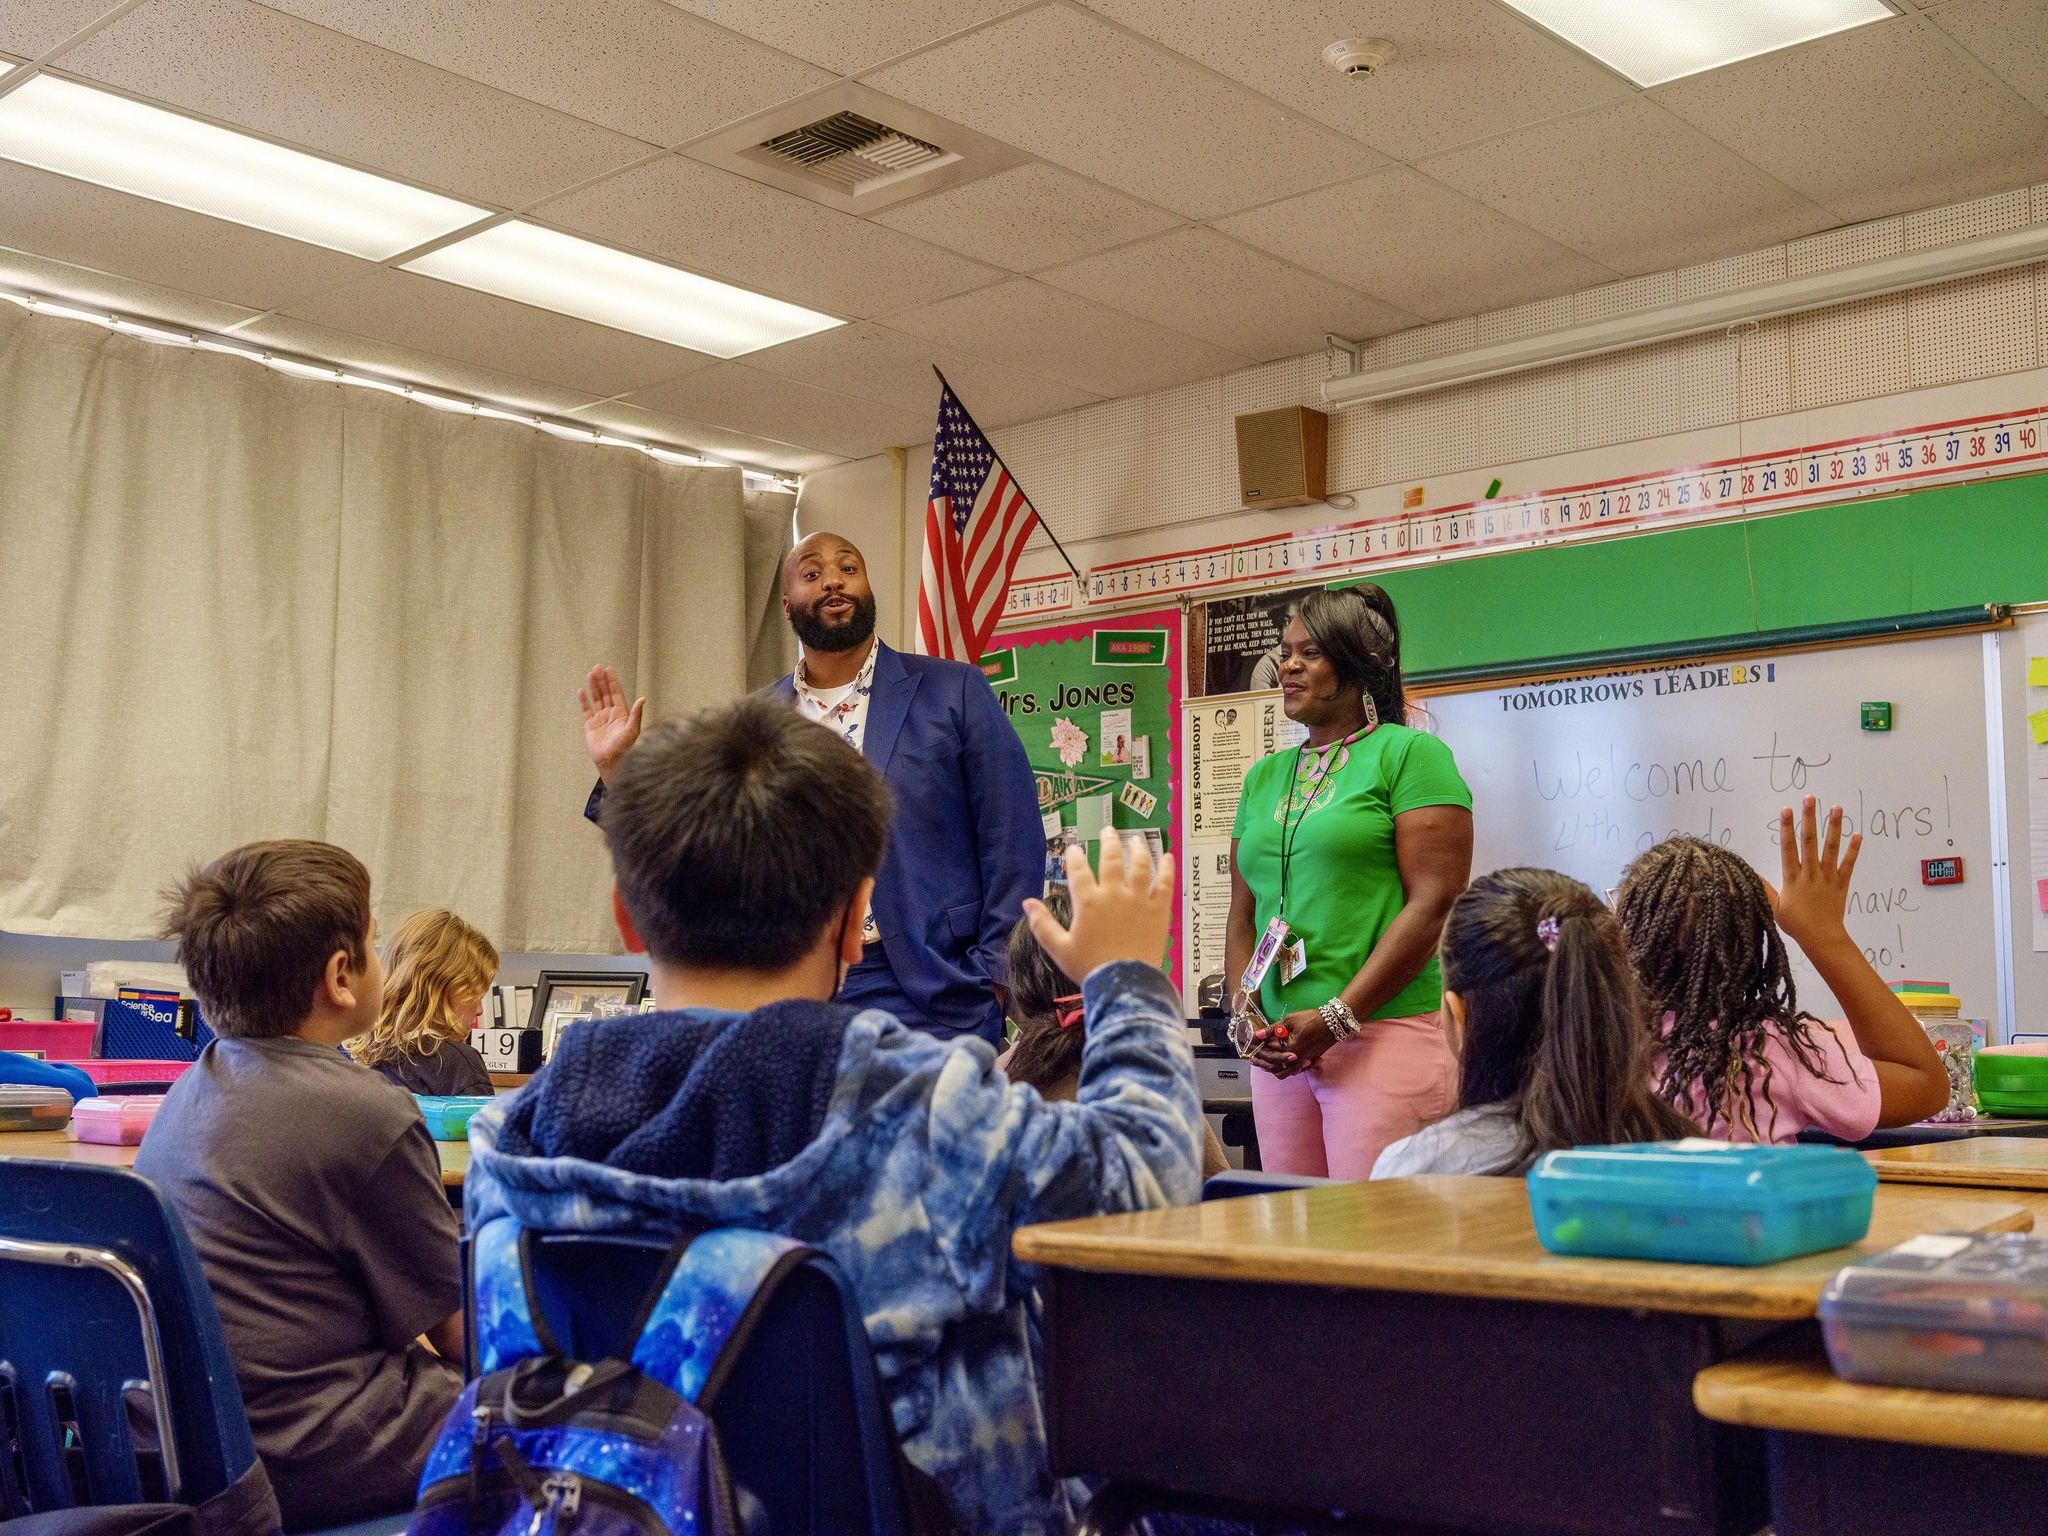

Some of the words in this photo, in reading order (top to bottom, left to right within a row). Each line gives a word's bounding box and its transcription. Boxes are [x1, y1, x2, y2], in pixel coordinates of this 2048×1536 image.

[1021, 593, 1030, 607] -14
[1034, 591, 1044, 605] -13
[1048, 589, 1056, 603] -12
[1060, 587, 1069, 601] -11
[1093, 581, 1103, 595] -10
[1107, 578, 1115, 593] -9
[1121, 577, 1128, 591] -8
[1135, 574, 1141, 589] -7
[1148, 572, 1156, 587] -6
[1162, 569, 1170, 584] -5
[1176, 567, 1185, 582] -4
[1192, 565, 1200, 580] -3
[1207, 562, 1214, 577] -2
[1238, 558, 1243, 573] 0
[1268, 553, 1273, 568] 2
[1283, 550, 1288, 565] 3
[1299, 547, 1305, 562] 4
[1316, 544, 1321, 560] 5
[1333, 542, 1338, 558] 6
[1349, 539, 1354, 555] 7
[1365, 537, 1371, 552] 8
[1382, 534, 1387, 549] 9
[1397, 531, 1405, 547] 10
[1415, 528, 1423, 545] 11
[1433, 525, 1441, 542] 12
[1450, 523, 1458, 539] 13
[1466, 519, 1475, 536] 14
[1484, 516, 1494, 534] 15
[1503, 513, 1512, 530] 16
[1522, 511, 1531, 528] 17
[1540, 508, 1550, 525] 18
[1560, 505, 1570, 522] 19
[1579, 502, 1591, 520] 20
[1600, 498, 1610, 517] 21
[1618, 496, 1630, 514] 22
[1638, 492, 1650, 510] 23
[1657, 489, 1670, 507] 24
[1678, 485, 1690, 504] 25
[1700, 482, 1711, 500] 26
[1719, 478, 1731, 497] 27
[1741, 475, 1754, 494] 28
[1763, 471, 1776, 491] 29
[1785, 468, 1798, 487] 30
[1808, 464, 1819, 483] 31
[1830, 460, 1844, 479] 32
[1852, 456, 1866, 476] 33
[1875, 452, 1889, 472] 34
[1899, 448, 1912, 468] 35
[1922, 445, 1936, 464] 36
[1946, 440, 1960, 461] 37
[1970, 437, 1985, 457] 38
[1995, 432, 2010, 453] 39
[2020, 428, 2036, 449] 40
[1247, 612, 1257, 620] THEN
[1248, 621, 1258, 629] THEN
[1500, 680, 1644, 712] TOMORROWS
[1532, 744, 1736, 801] Welcome
[1753, 731, 1831, 793] to
[1194, 792, 1202, 810] BE
[1194, 813, 1202, 831] TO
[1192, 906, 1200, 973] EBONY
[122, 1000, 154, 1010] Science
[147, 1008, 172, 1023] Sea
[483, 1061, 508, 1069] UGUST
